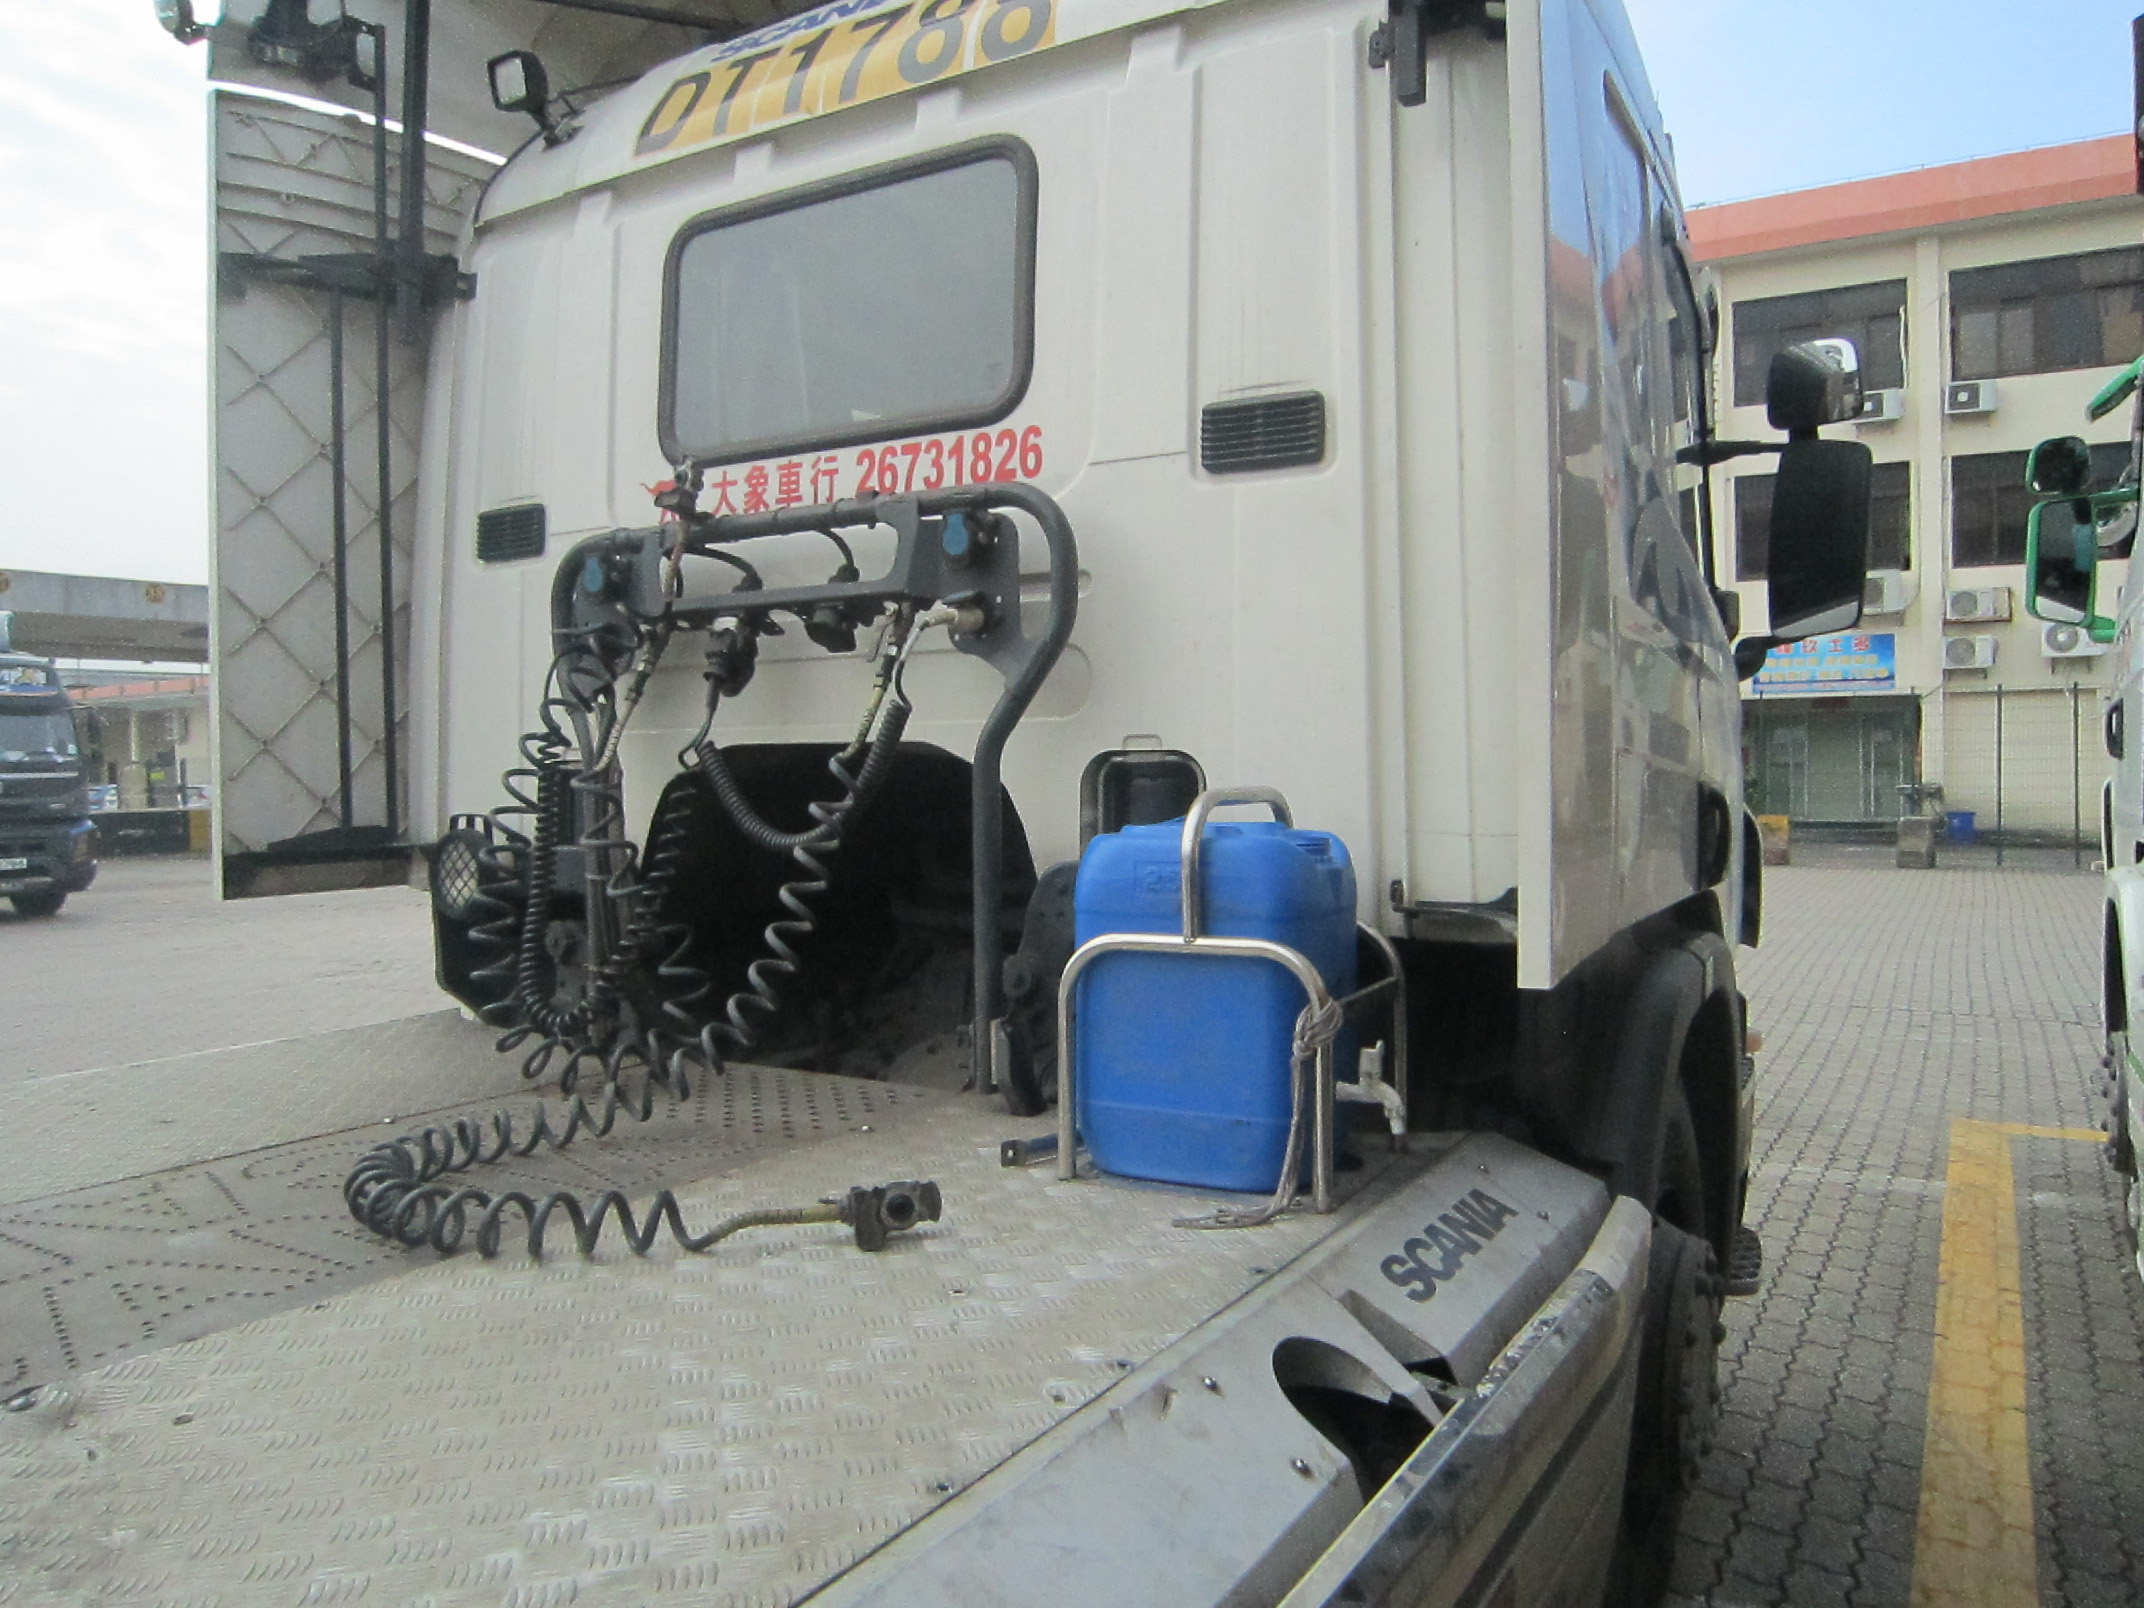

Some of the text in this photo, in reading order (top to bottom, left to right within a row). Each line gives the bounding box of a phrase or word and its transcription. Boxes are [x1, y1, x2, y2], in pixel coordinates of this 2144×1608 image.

[711, 425, 1043, 516] 大象車行 26731826
[1380, 1188, 1520, 1304] SCANIA
